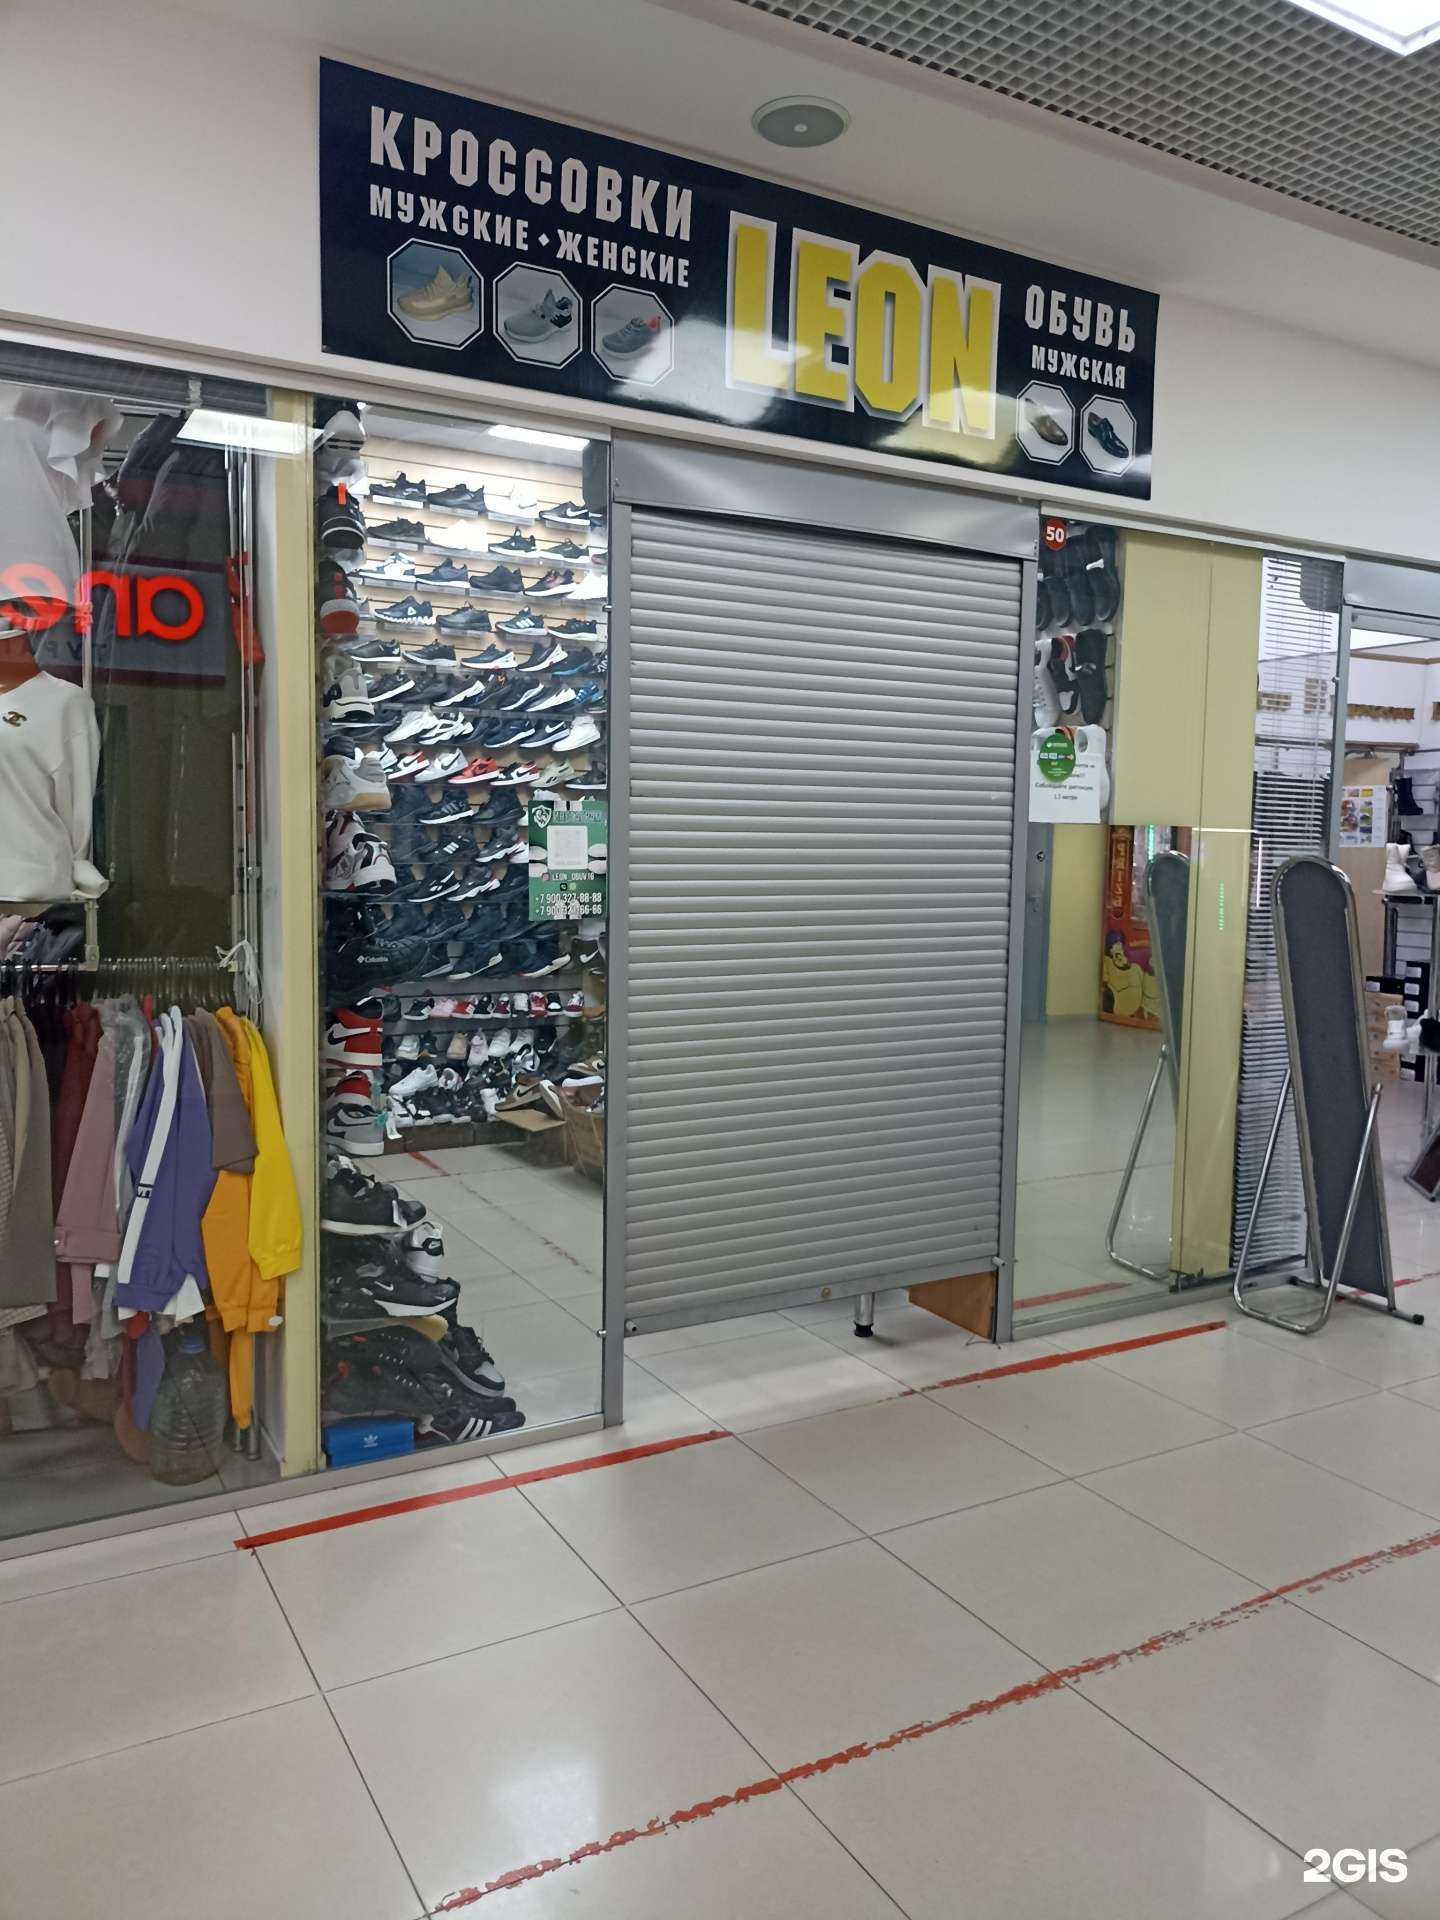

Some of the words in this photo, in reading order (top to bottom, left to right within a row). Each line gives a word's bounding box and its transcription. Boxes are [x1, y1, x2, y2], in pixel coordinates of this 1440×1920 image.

[370, 105, 693, 241] КРОССОВКИ
[369, 184, 529, 251] МУЖСКИЕ
[556, 229, 690, 288] ЖЕНСКИЕ
[725, 210, 1001, 440] LEON
[1024, 284, 1136, 353] ОБУВЬ
[1031, 344, 1126, 390] МУЖСКАЯ
[1046, 526, 1064, 543] 50
